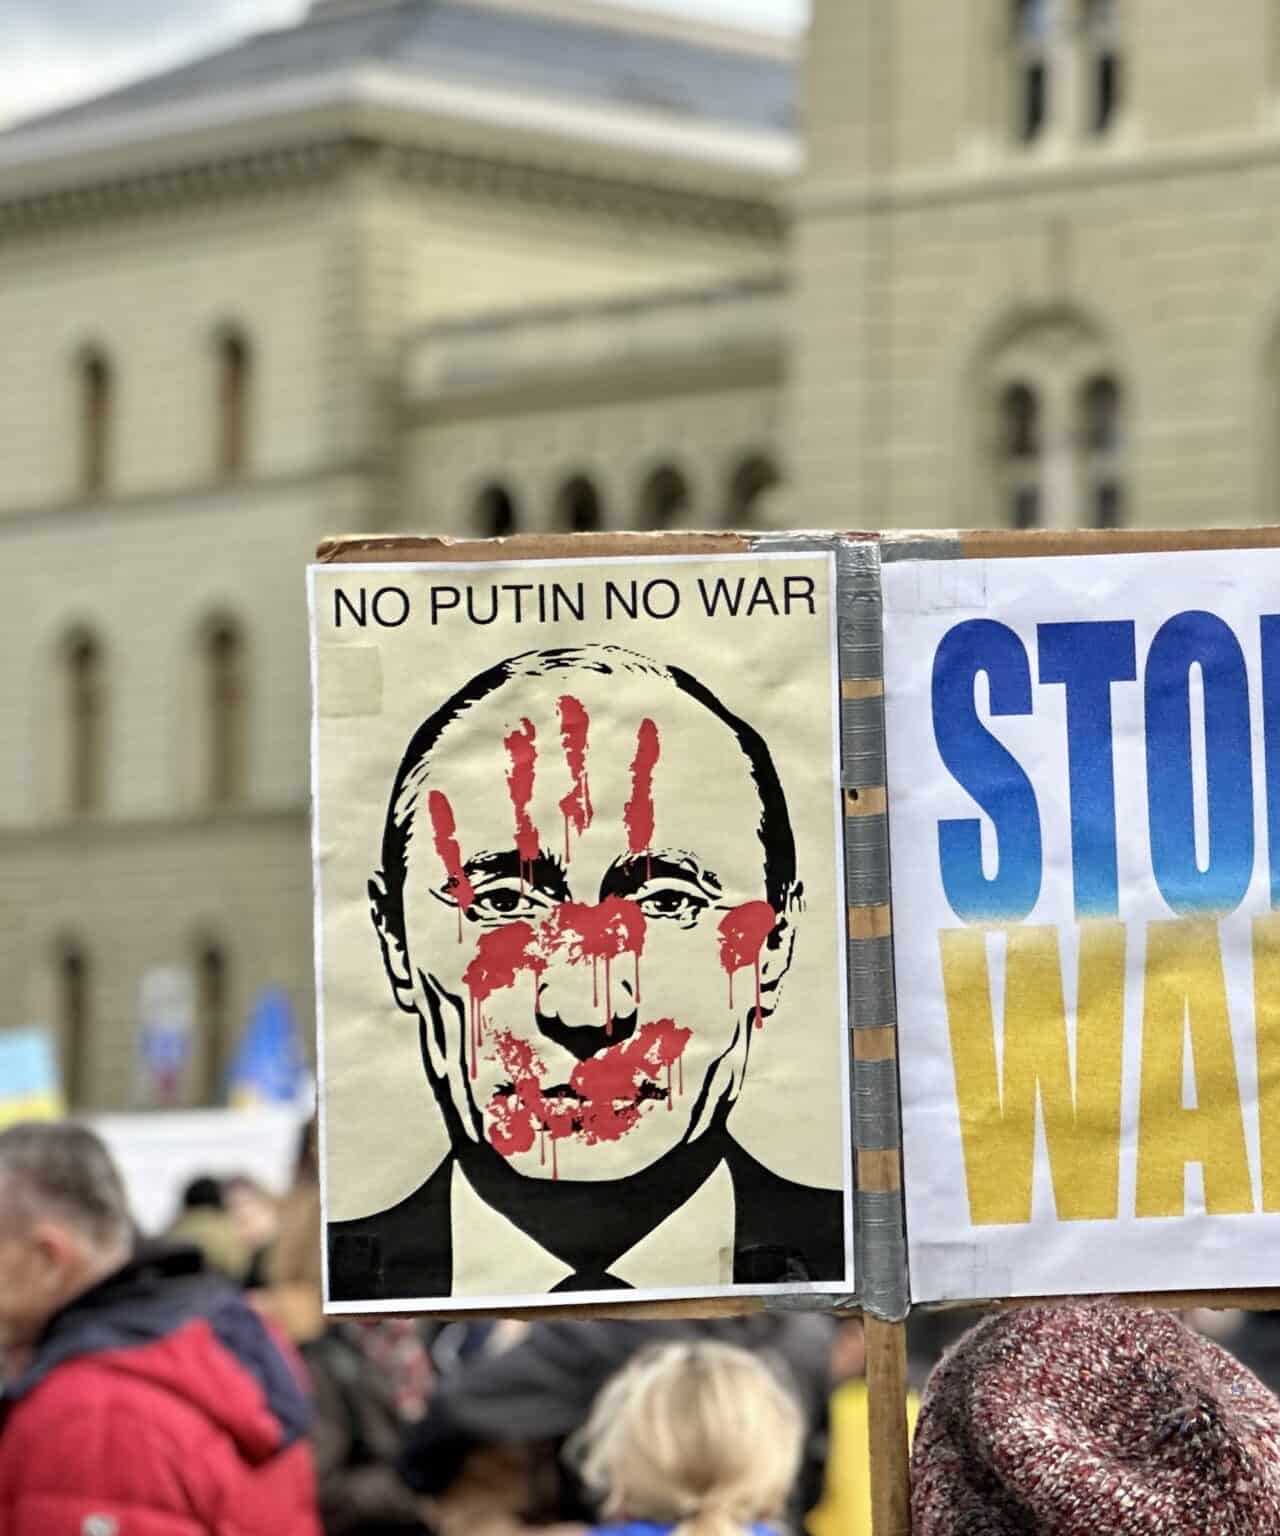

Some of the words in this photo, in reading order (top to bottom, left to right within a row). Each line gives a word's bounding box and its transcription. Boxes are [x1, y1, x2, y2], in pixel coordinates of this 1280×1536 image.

[333, 586, 410, 628] NO
[430, 581, 585, 626] PUTIN
[604, 578, 681, 621] NO
[698, 575, 817, 617] WAR
